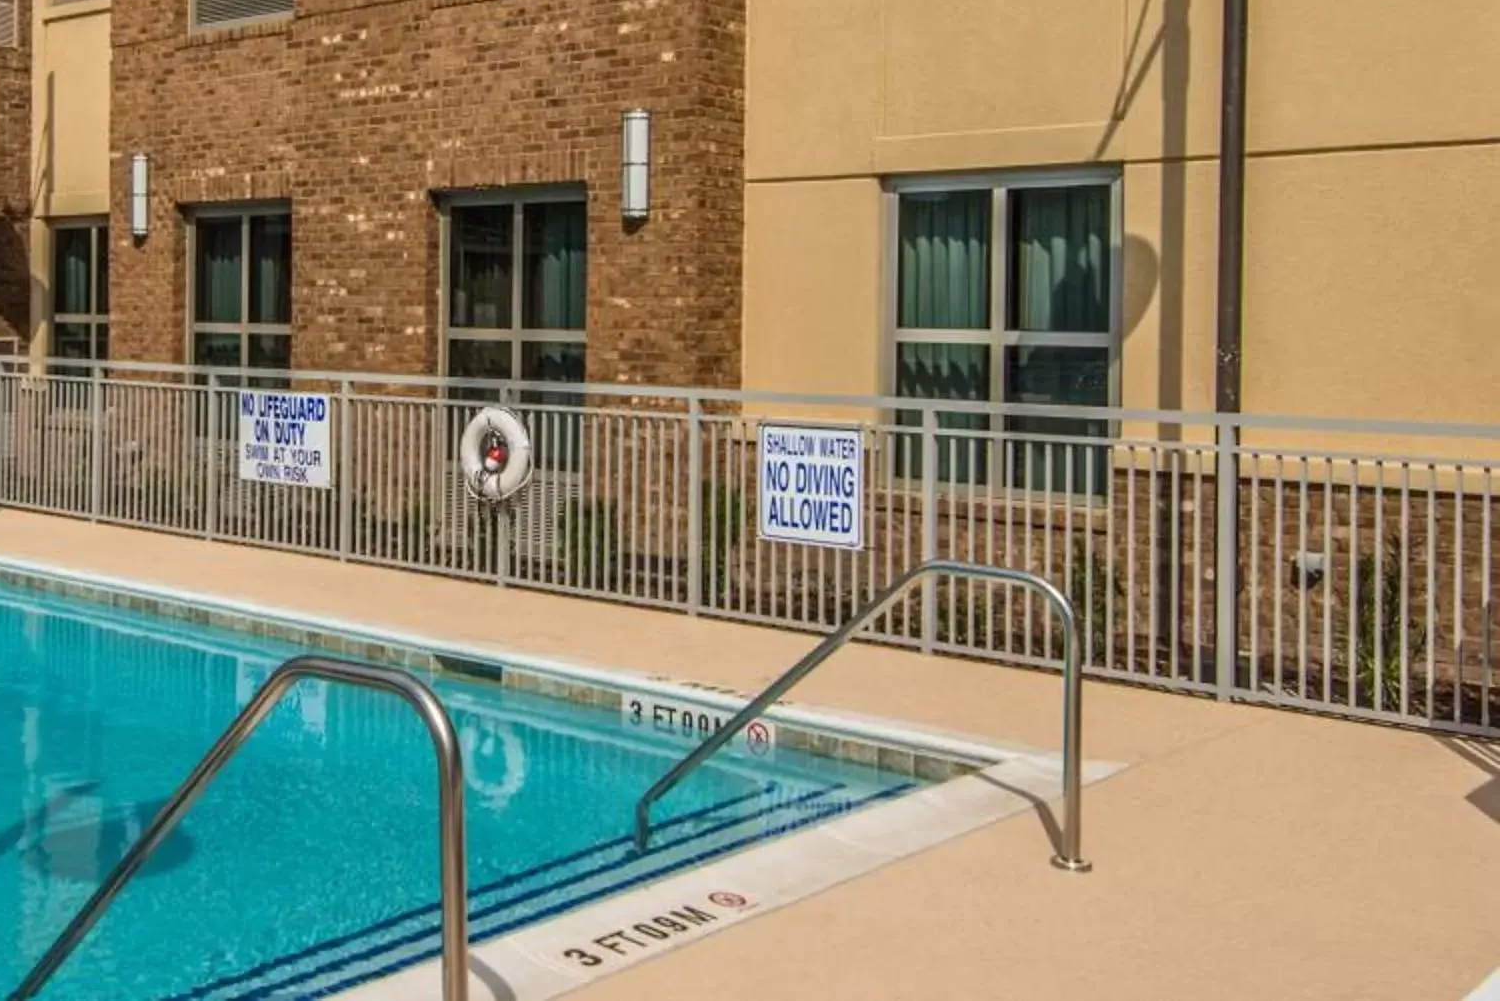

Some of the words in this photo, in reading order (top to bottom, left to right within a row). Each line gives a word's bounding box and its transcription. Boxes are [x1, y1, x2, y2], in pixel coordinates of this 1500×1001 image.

[242, 392, 255, 416] NO
[259, 395, 325, 421] LIFEGUARD
[255, 419, 269, 442] ON
[274, 421, 306, 445] DUTY
[245, 442, 269, 460] SWIM
[273, 446, 285, 462] AT
[291, 448, 321, 466] YOUR
[767, 432, 815, 456] SHALLOW
[820, 436, 856, 459] WATER
[257, 462, 280, 478] OWN
[284, 465, 308, 483] RISK
[766, 460, 790, 492] NO
[796, 462, 854, 498] DIVING
[768, 495, 852, 533] ALLOWED
[563, 948, 603, 967] 3
